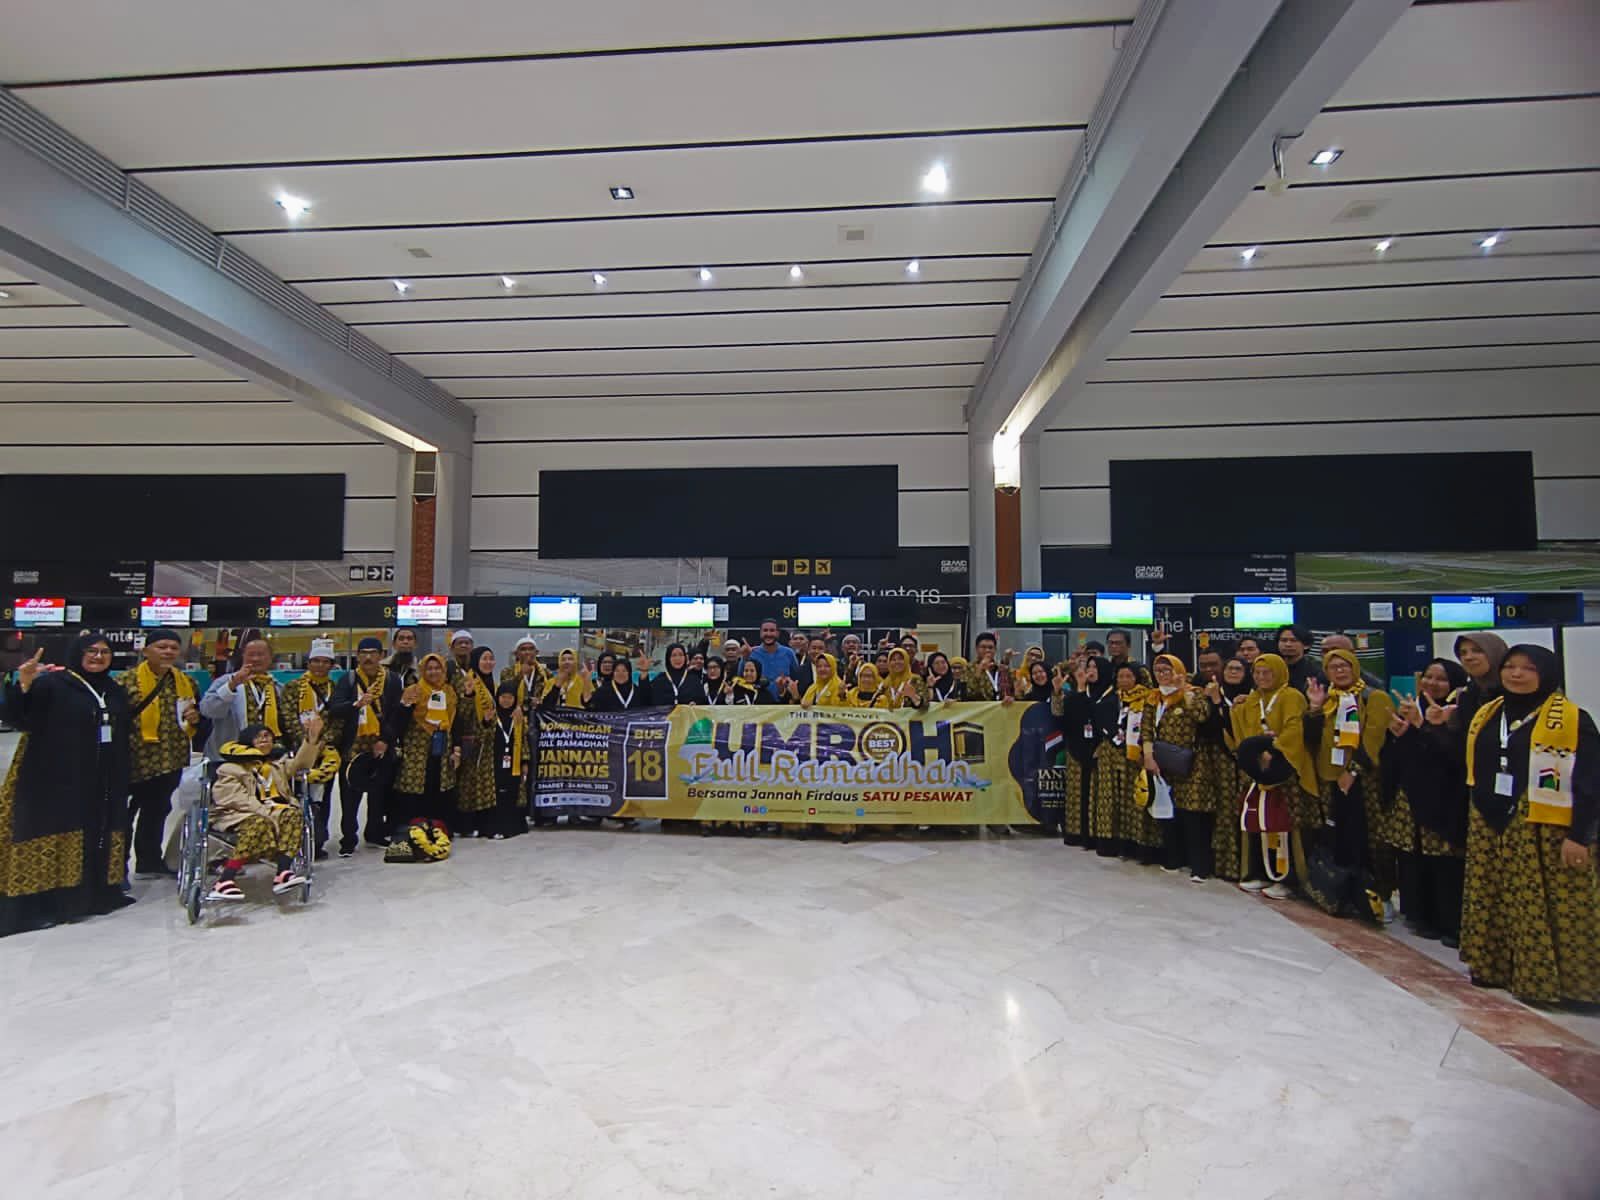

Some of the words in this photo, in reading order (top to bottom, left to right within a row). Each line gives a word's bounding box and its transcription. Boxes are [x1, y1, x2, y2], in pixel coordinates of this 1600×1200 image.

[647, 607, 661, 619] 95
[783, 607, 798, 619] 96
[996, 606, 1012, 618] 97
[1078, 606, 1094, 618] 98
[842, 712, 880, 720] TRAVEL
[634, 729, 665, 739] BUS
[557, 740, 609, 748] RAMADHAN
[714, 719, 953, 768] UMROH
[868, 739, 896, 748] BEST
[540, 750, 609, 763] JANNAH
[538, 764, 609, 778] FIRDAUS
[627, 750, 662, 782] 18
[694, 751, 762, 784] Full
[772, 751, 970, 786] Ramadhan
[1038, 769, 1066, 780] JAN
[687, 788, 747, 800] Bersama
[750, 789, 802, 801] Jannah
[806, 790, 859, 802] Firdaus
[863, 791, 900, 803] SATU
[904, 791, 973, 803] PESAWAT
